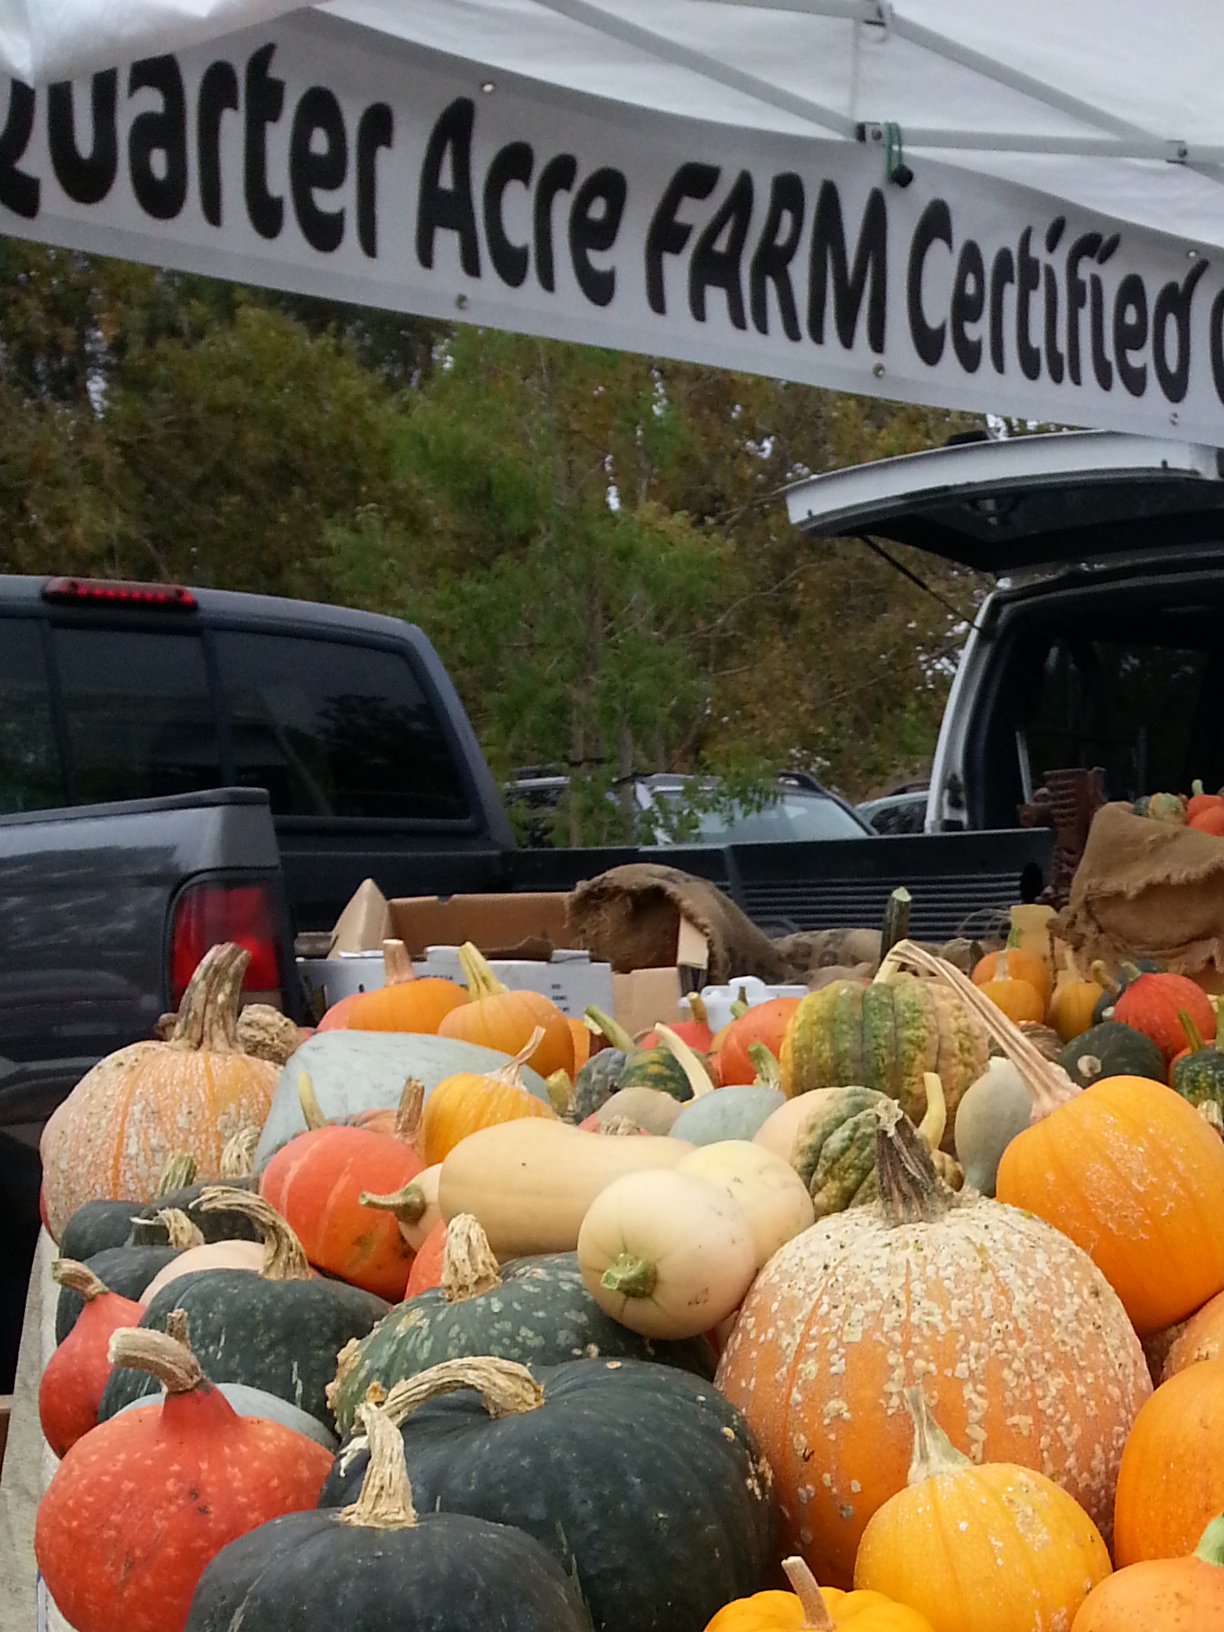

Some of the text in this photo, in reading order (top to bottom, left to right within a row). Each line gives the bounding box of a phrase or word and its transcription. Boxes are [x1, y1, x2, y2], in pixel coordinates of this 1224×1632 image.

[416, 96, 628, 307] Acre
[645, 160, 887, 355] FARM
[905, 197, 1209, 404] Certified
